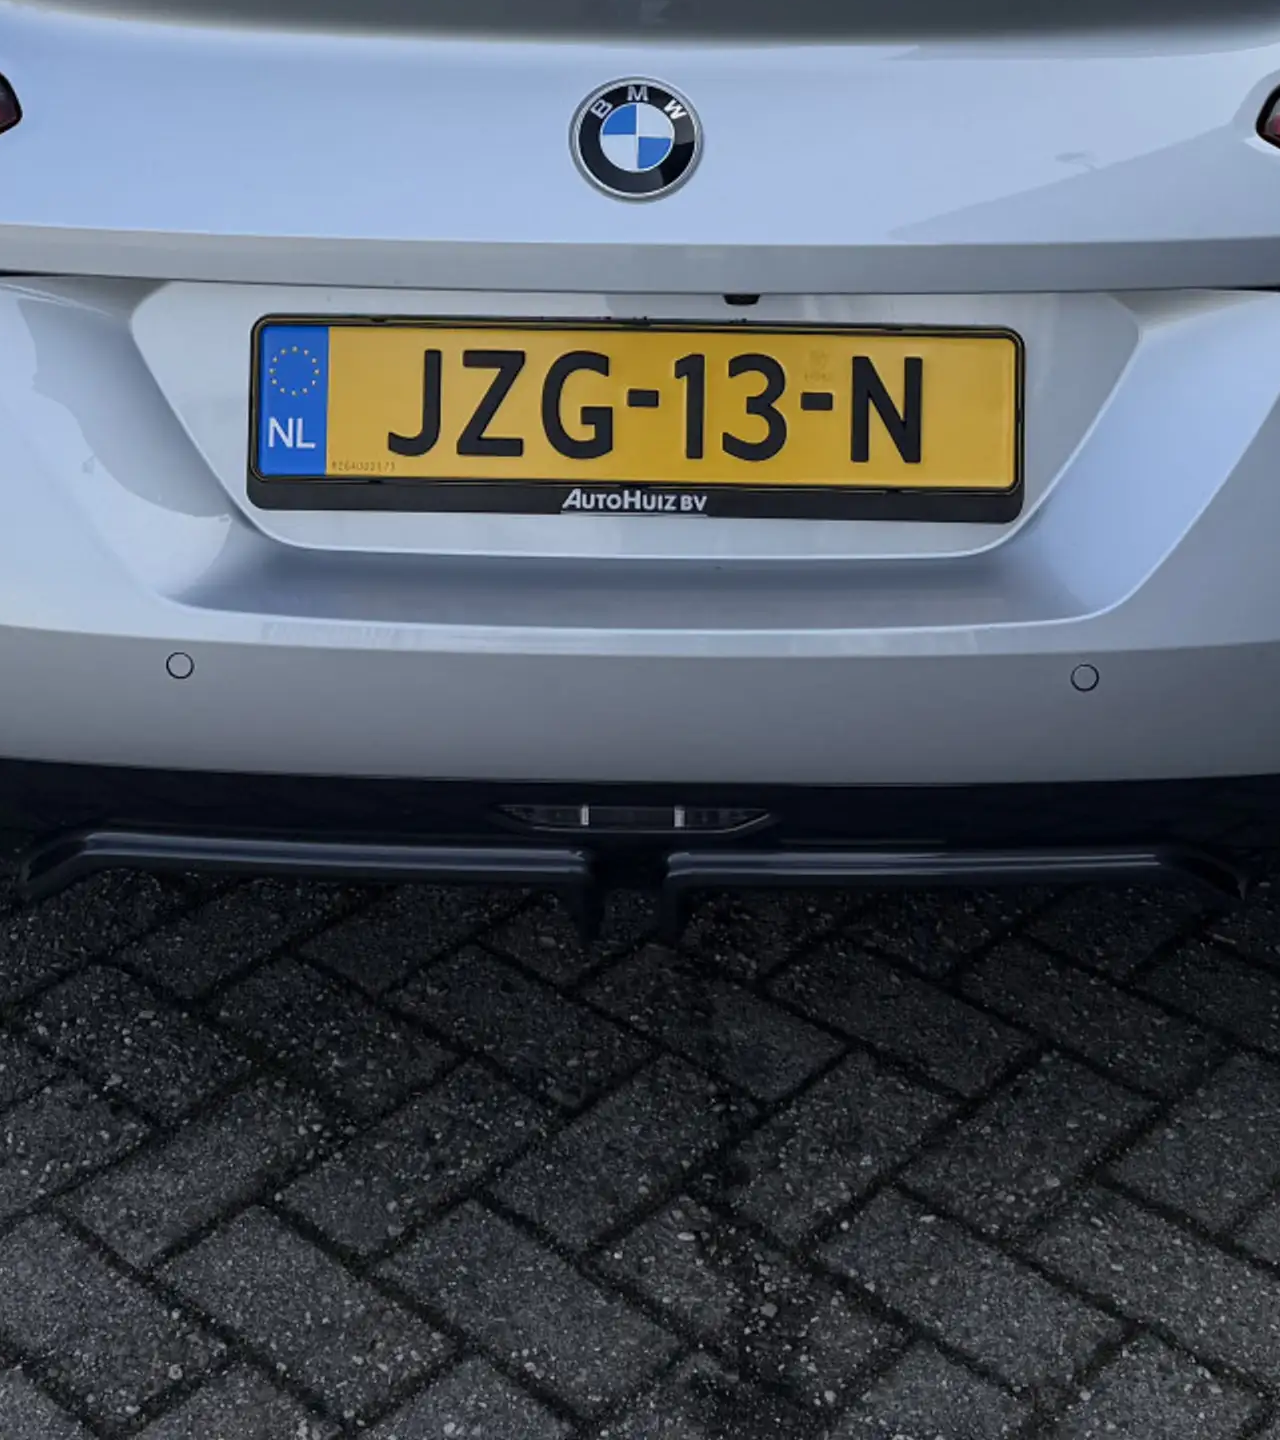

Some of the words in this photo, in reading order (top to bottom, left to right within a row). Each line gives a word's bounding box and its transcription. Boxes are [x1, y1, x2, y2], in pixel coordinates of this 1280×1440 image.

[590, 86, 687, 119] BMW
[268, 417, 316, 449] NL
[388, 350, 923, 463] JZG-13-N
[680, 495, 708, 511] BV
